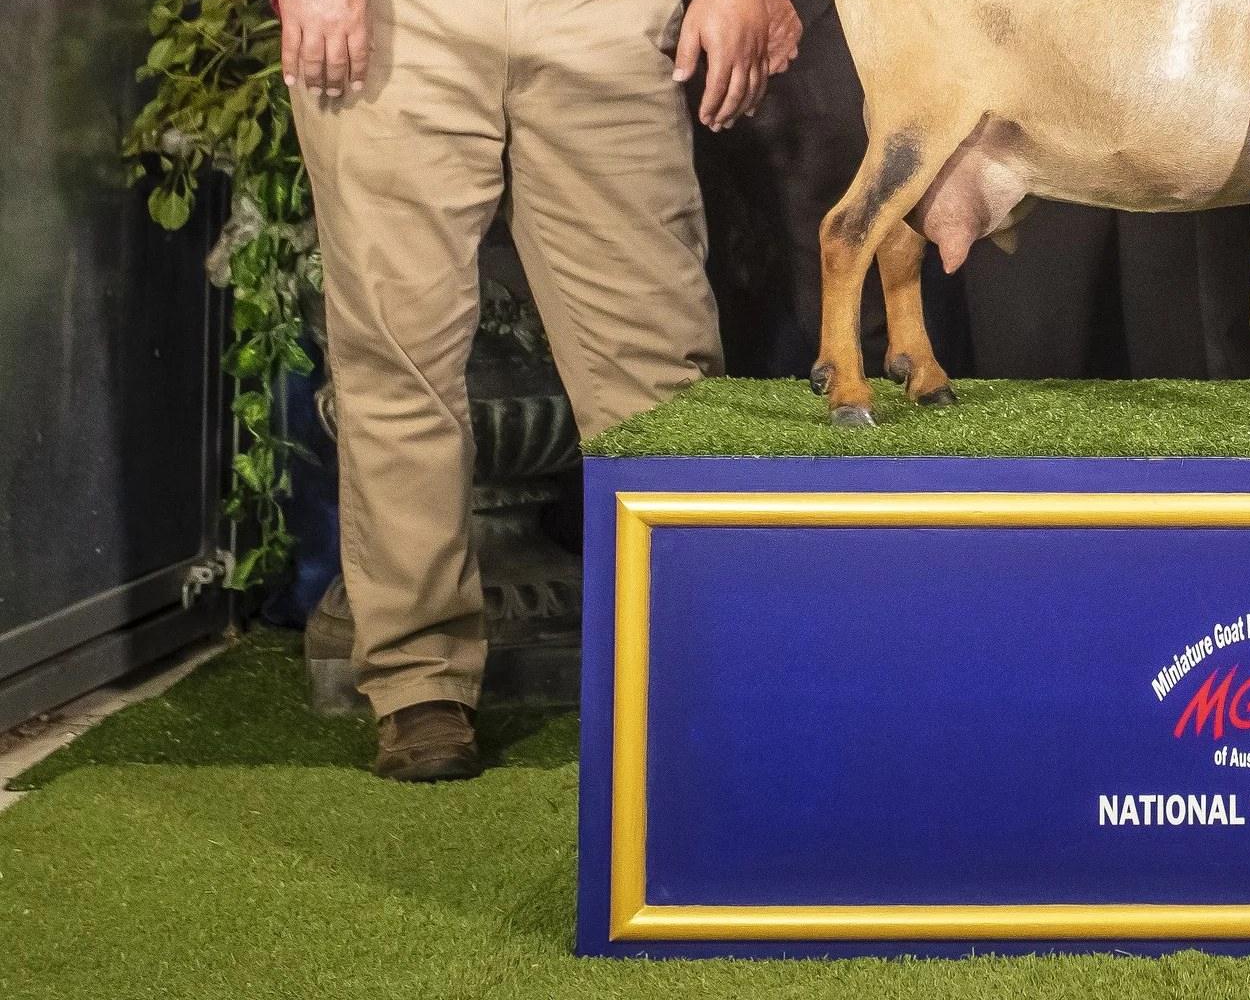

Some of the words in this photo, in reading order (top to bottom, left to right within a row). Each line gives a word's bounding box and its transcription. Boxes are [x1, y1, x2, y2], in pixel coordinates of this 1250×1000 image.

[1151, 637, 1215, 701] Miniature
[1214, 616, 1245, 650] Goat
[1214, 746, 1228, 766] of
[1099, 794, 1246, 826] NATIONAL
